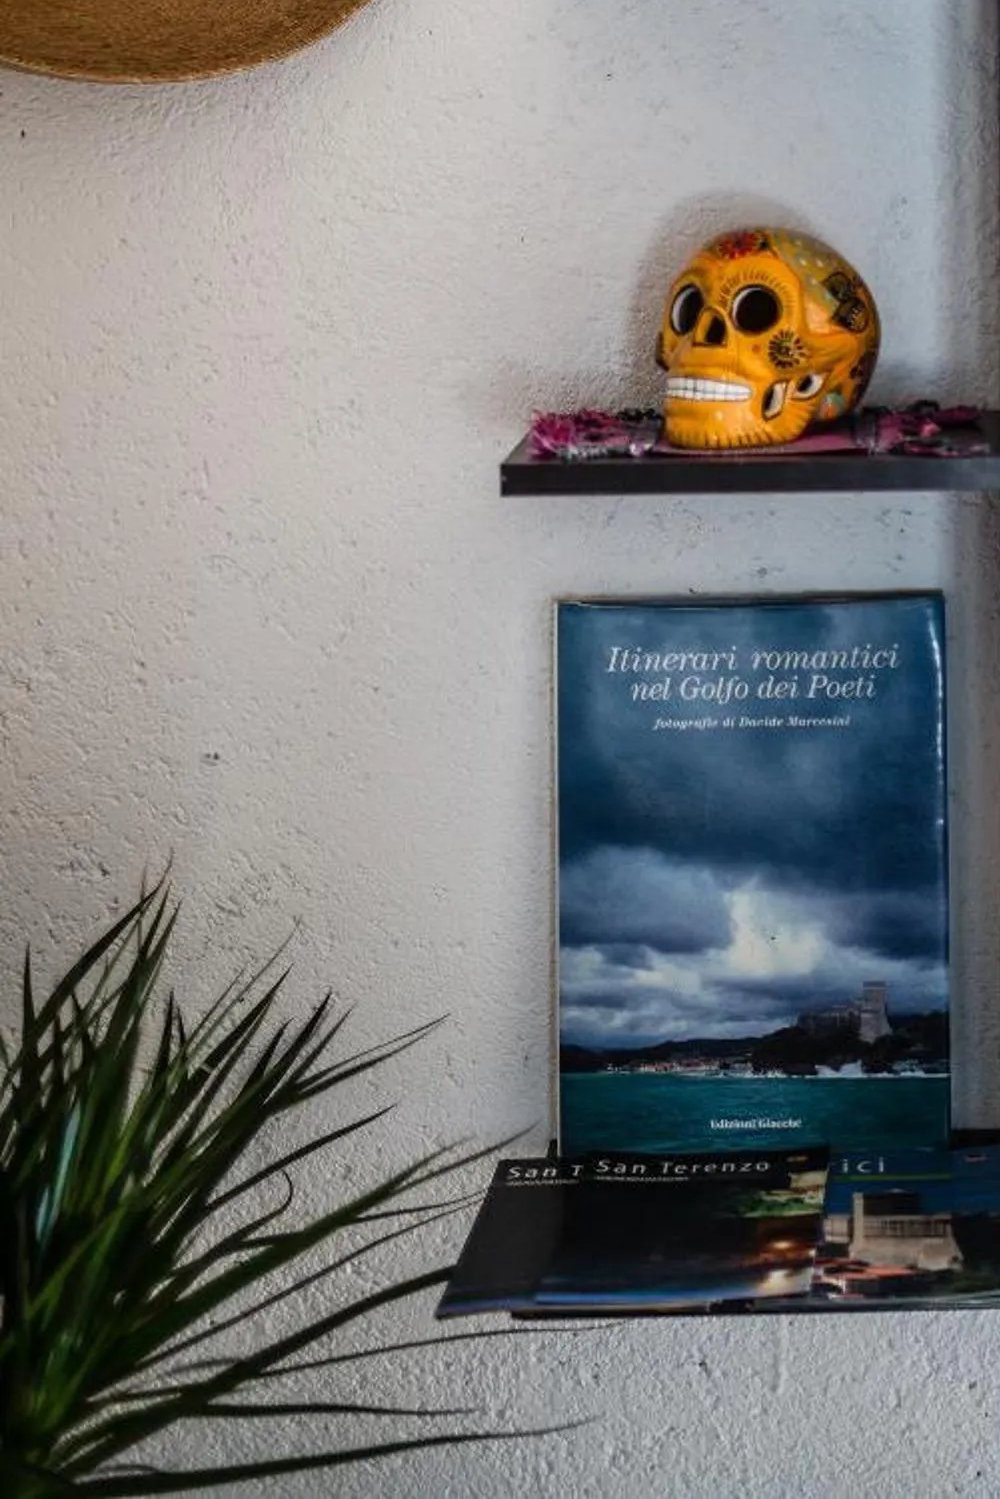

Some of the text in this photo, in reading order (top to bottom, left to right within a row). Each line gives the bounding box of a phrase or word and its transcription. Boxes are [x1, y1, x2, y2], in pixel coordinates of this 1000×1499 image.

[606, 643, 900, 673] Itinerari romantici
[631, 673, 878, 705] nel Golfo dei Poeti
[722, 715, 735, 728] di
[507, 1165, 558, 1179] San
[595, 1159, 771, 1176] San Terenzo
[841, 1157, 886, 1174] ici
